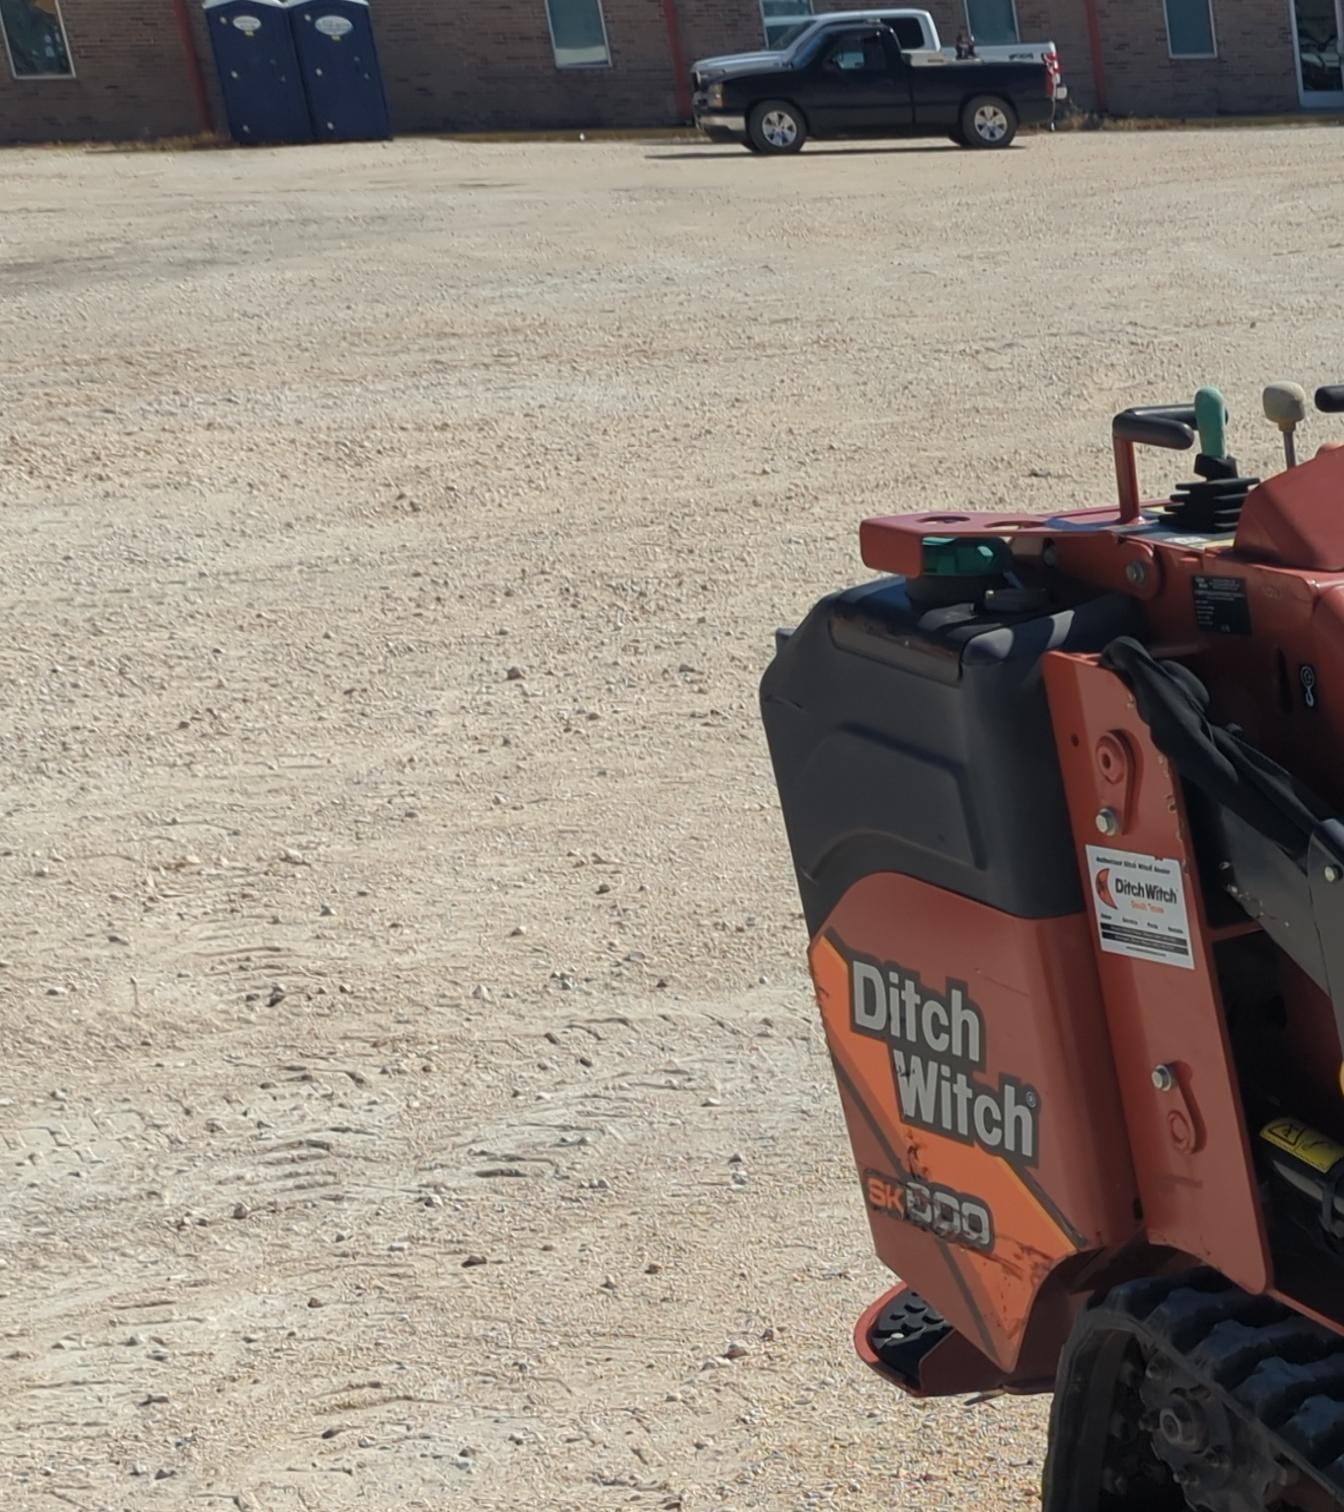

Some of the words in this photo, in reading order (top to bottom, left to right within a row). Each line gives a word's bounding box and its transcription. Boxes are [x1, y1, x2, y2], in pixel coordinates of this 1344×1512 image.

[1115, 878, 1144, 898] Ditch
[1145, 883, 1177, 904] Witch
[852, 959, 980, 1062] Ditch
[893, 1048, 1034, 1158] Witch
